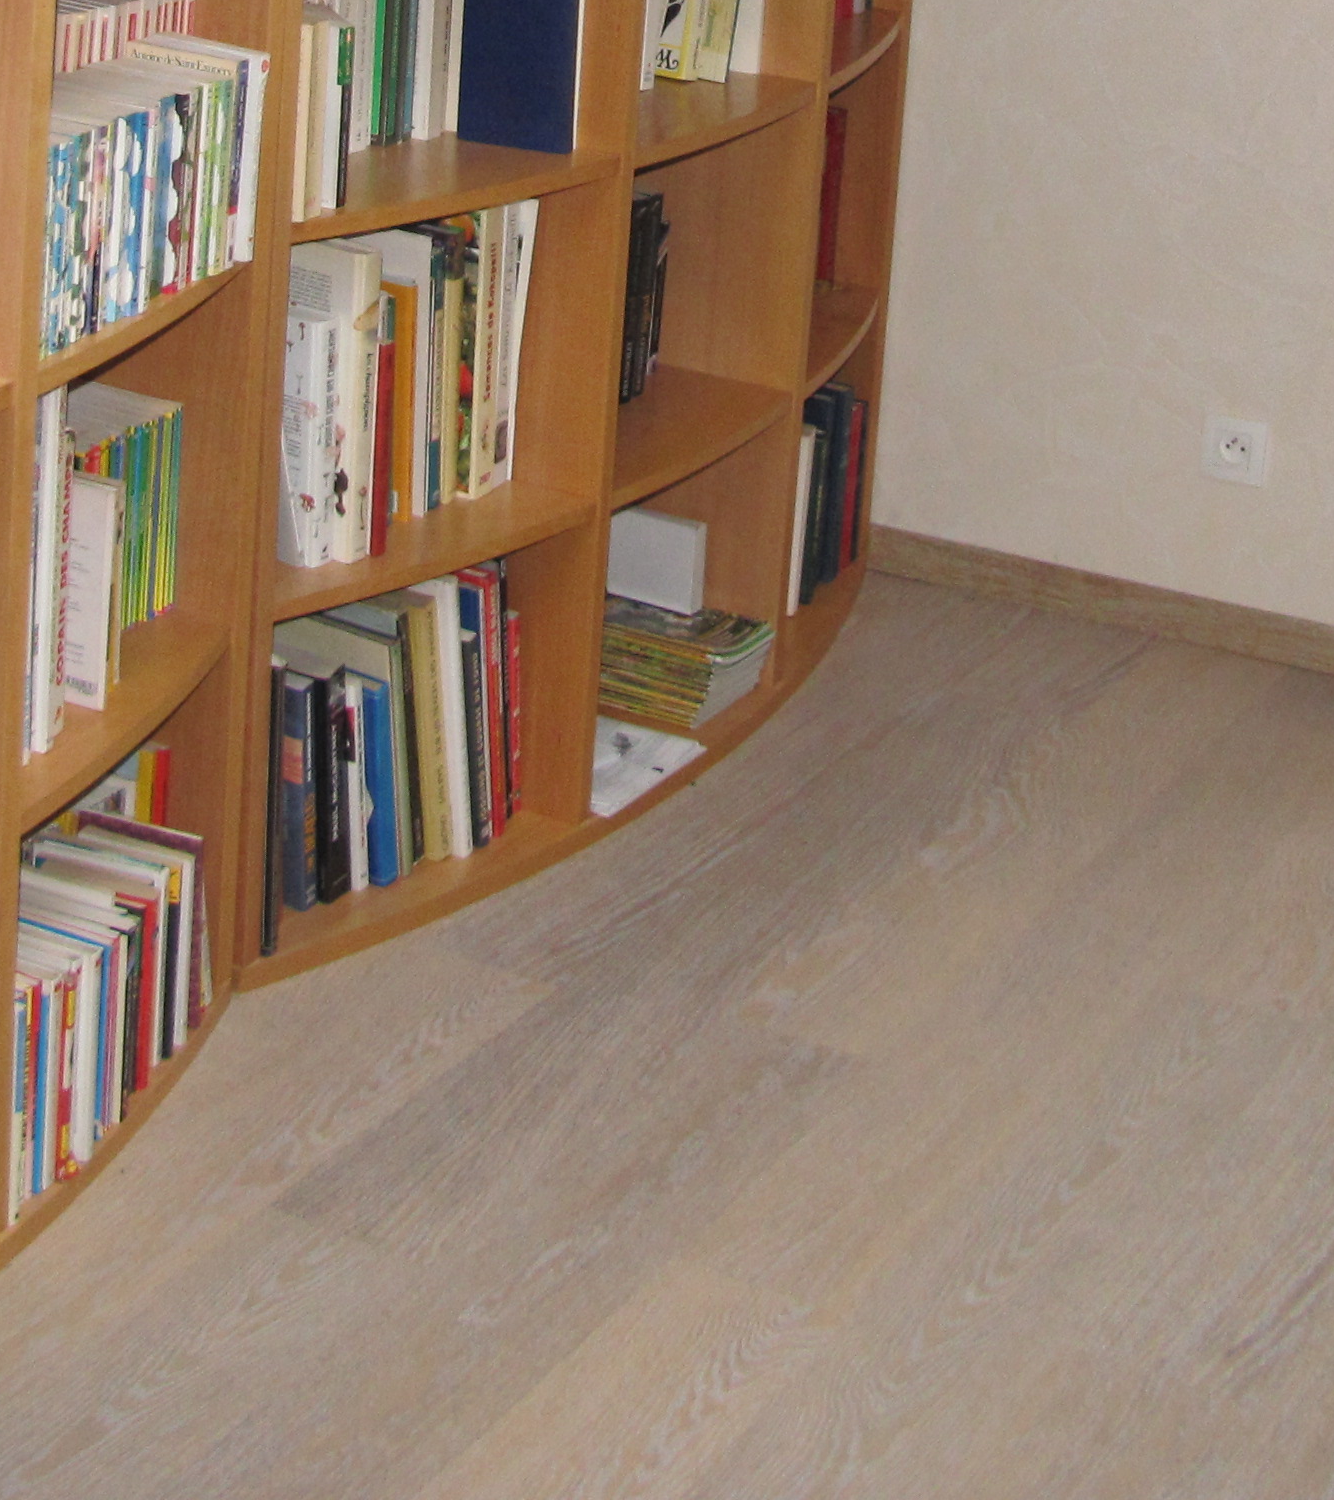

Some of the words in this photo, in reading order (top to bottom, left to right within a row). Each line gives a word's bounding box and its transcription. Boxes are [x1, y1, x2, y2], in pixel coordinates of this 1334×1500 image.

[61, 454, 73, 544] CHAMPS
[59, 550, 69, 590] DES
[55, 598, 67, 686] COPAIN
